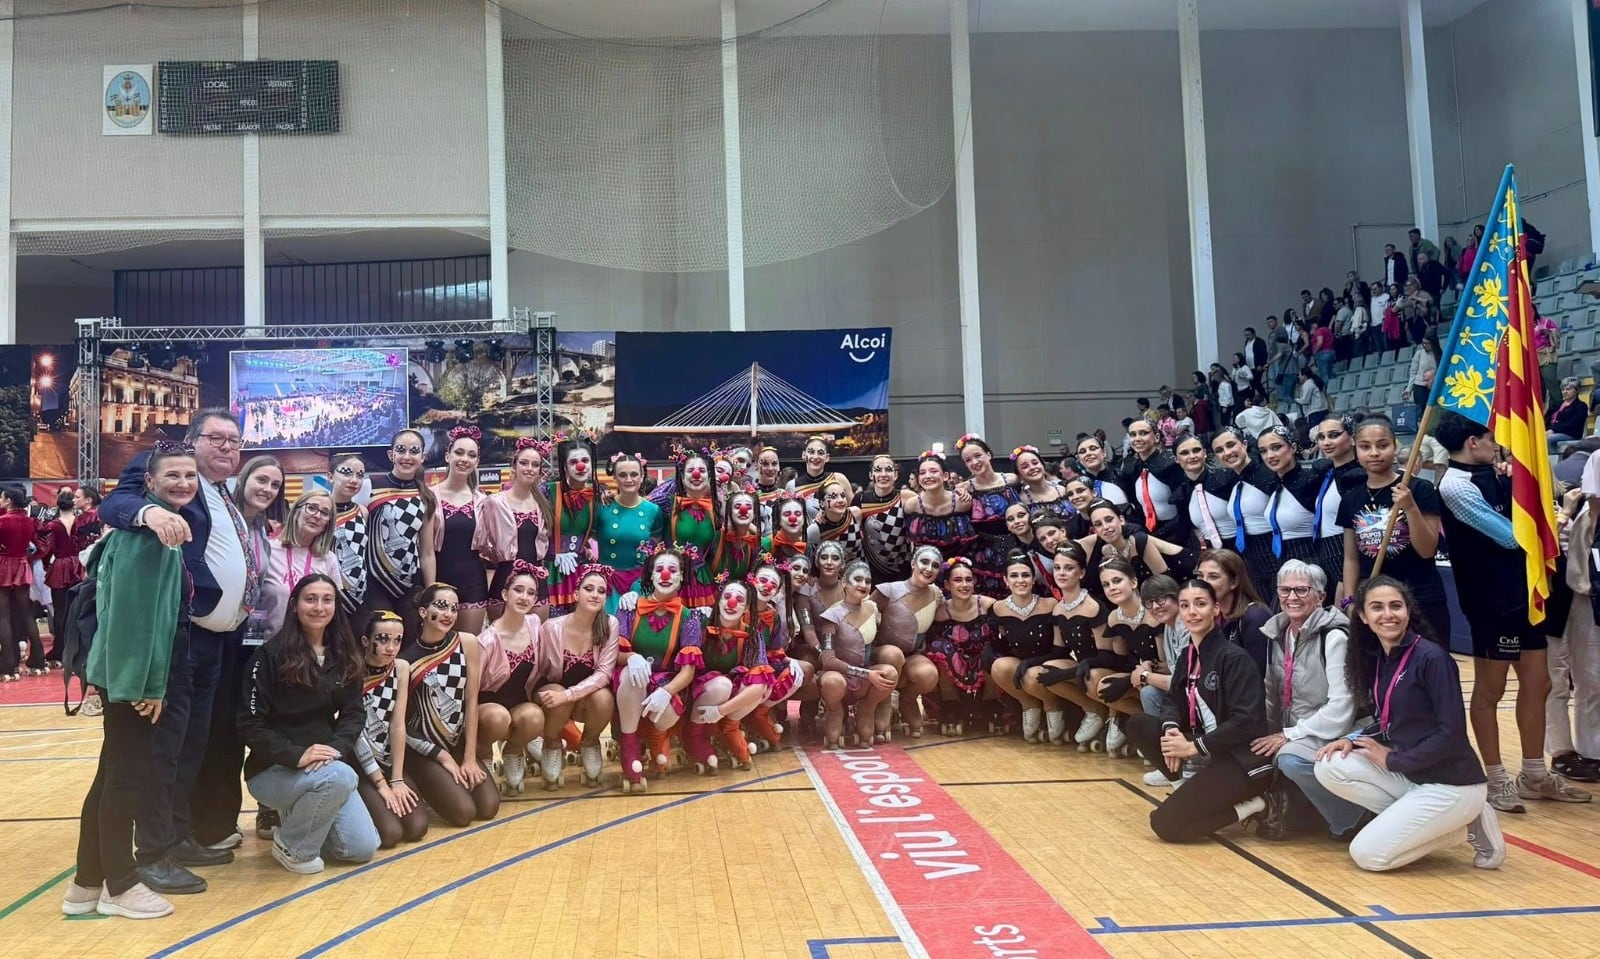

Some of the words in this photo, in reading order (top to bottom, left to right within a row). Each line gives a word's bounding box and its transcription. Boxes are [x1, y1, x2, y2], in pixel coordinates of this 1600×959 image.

[203, 80, 229, 89] LOCAL
[840, 333, 886, 350] Alcoi
[1360, 531, 1382, 540] GRUPOS
[880, 831, 981, 880] viu
[972, 923, 1038, 959] rts
